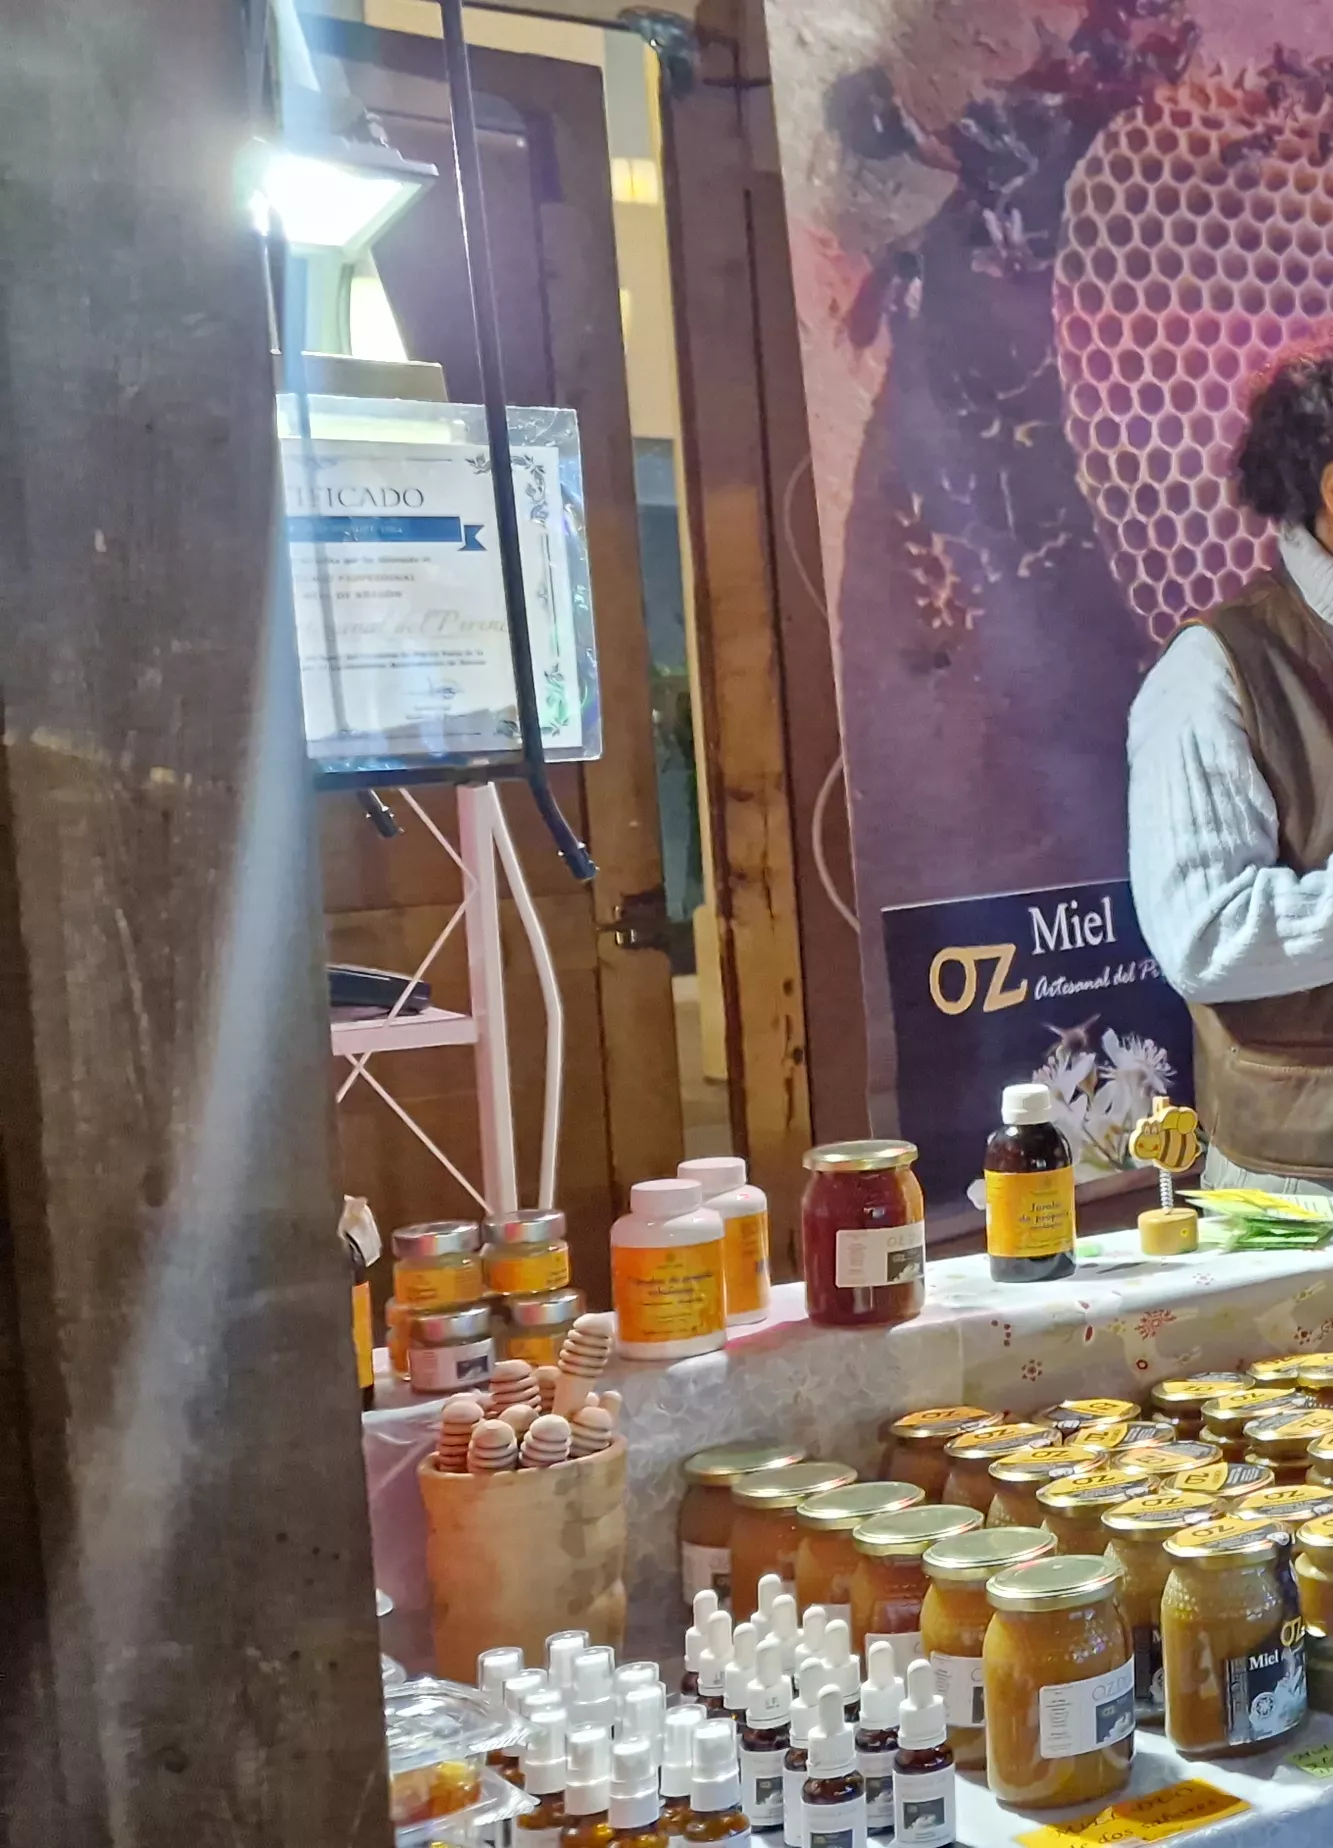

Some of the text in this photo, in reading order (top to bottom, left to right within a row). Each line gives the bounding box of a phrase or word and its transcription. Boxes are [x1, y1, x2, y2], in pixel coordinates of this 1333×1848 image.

[1028, 896, 1117, 955] Miel
[929, 943, 1028, 1015] OZ
[1034, 958, 1163, 1000] Artesanal del Pi
[1191, 1524, 1236, 1538] OZ
[1280, 1615, 1307, 1648] OZ
[1250, 1648, 1279, 1672] Miel
